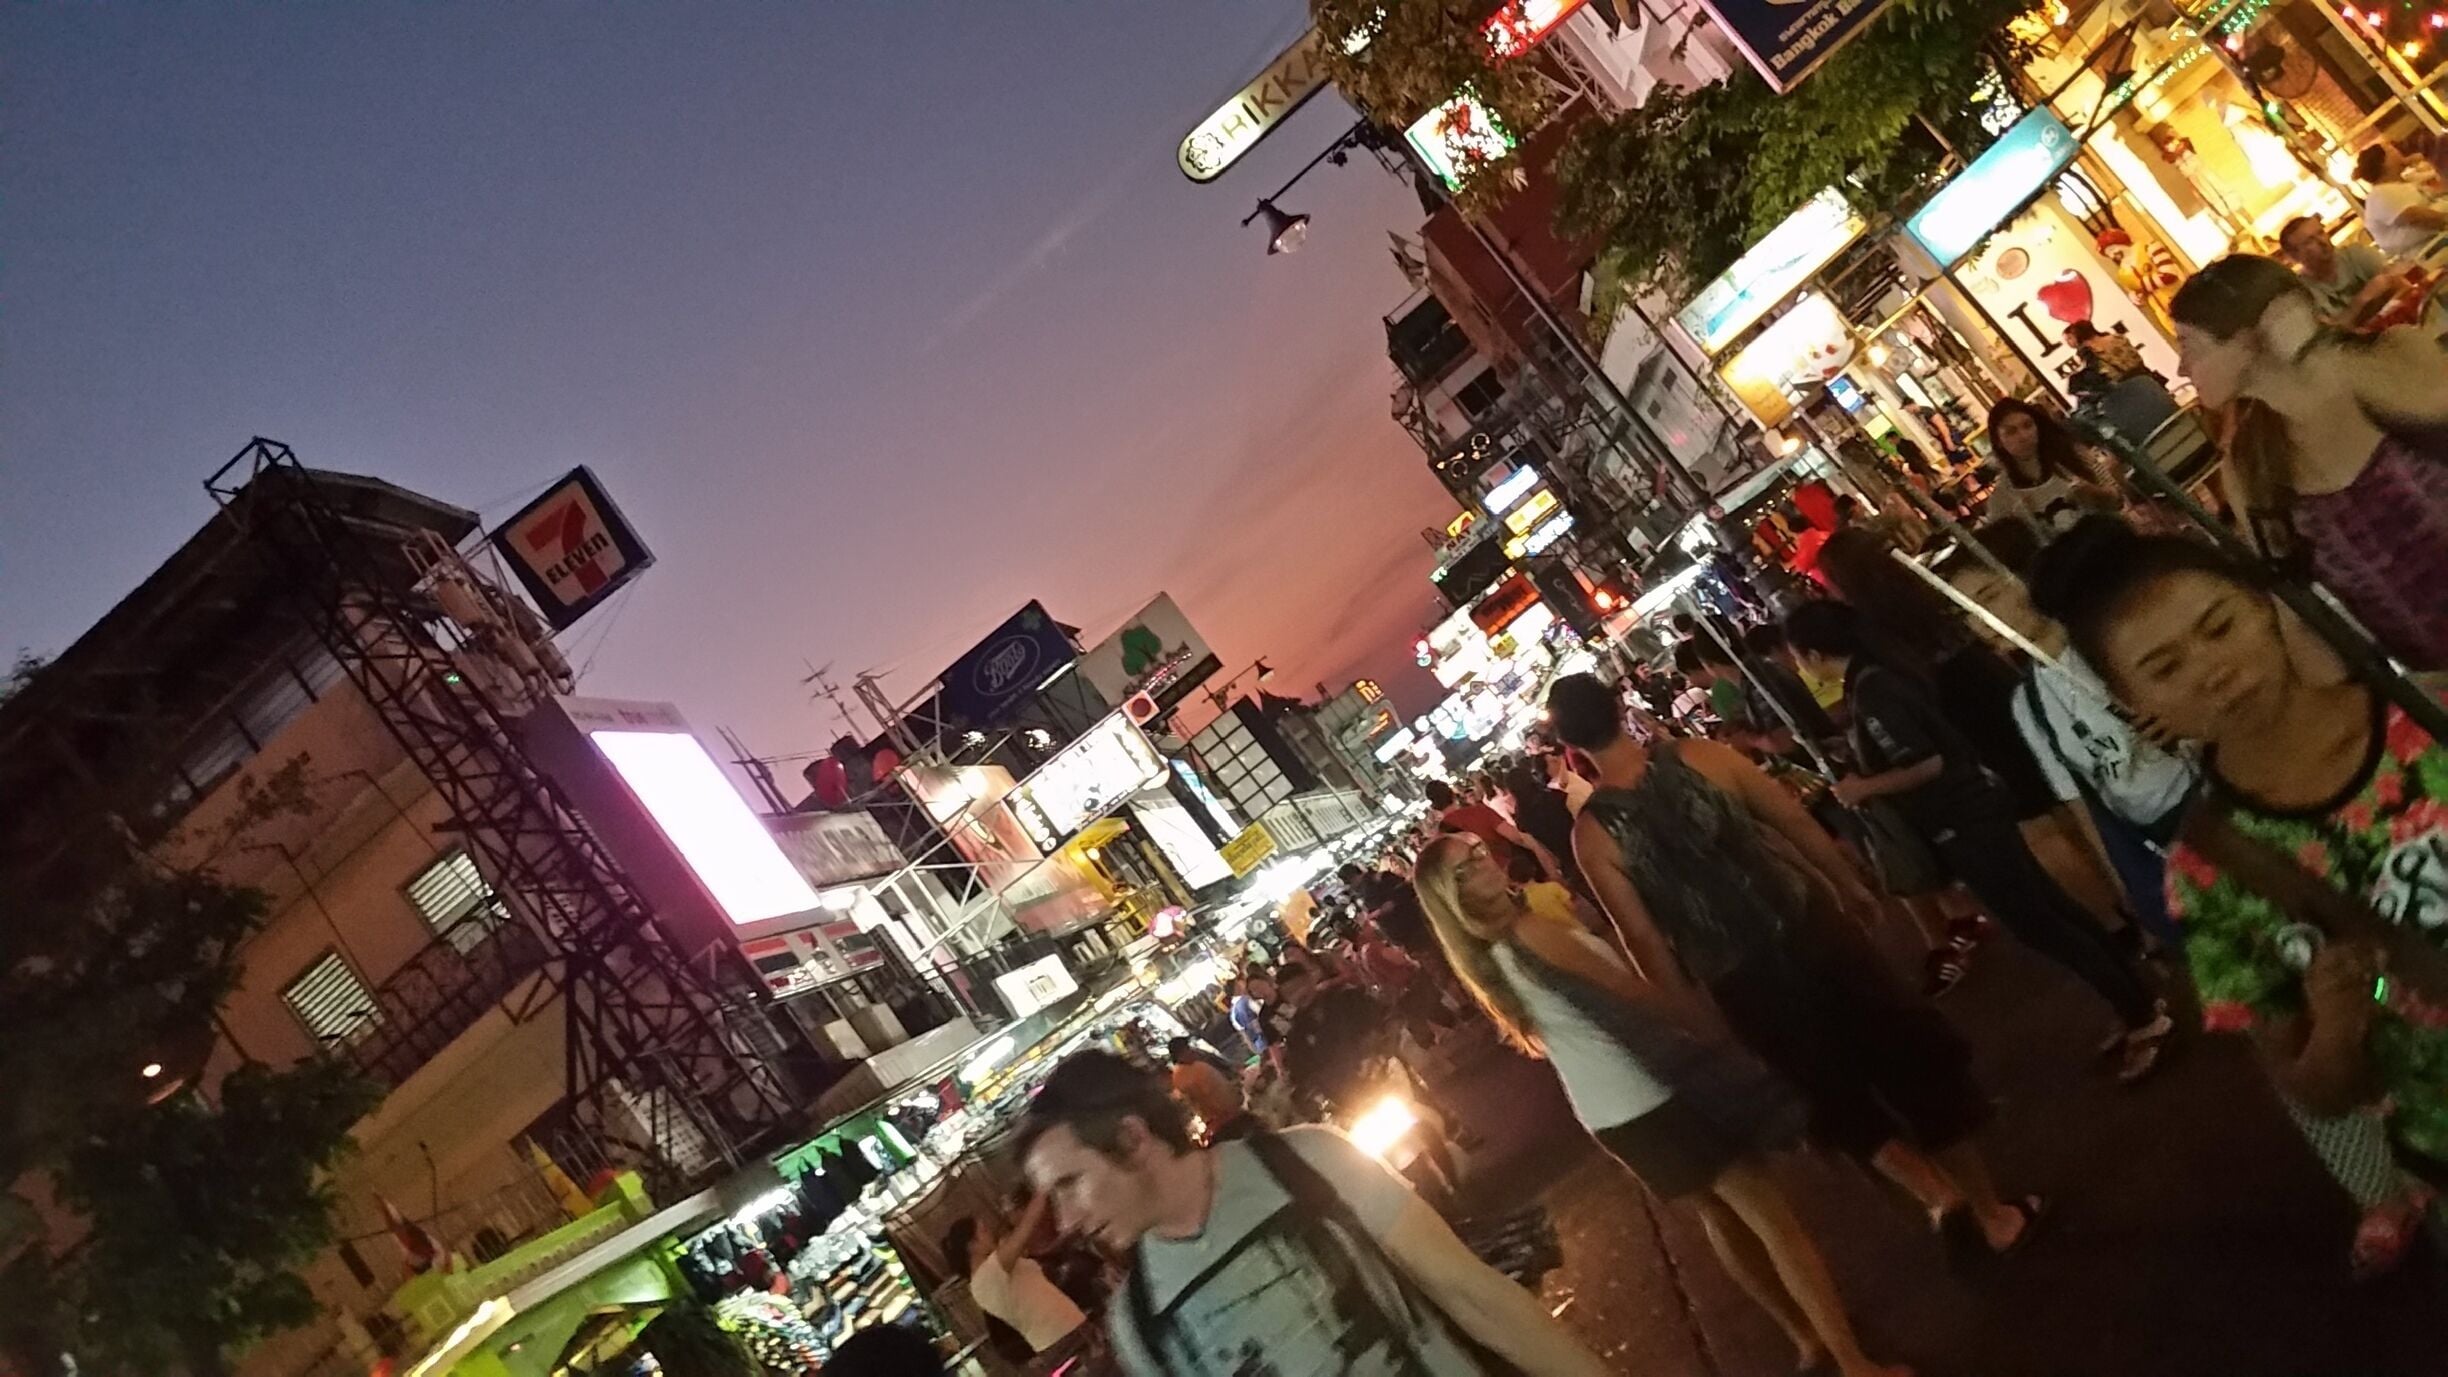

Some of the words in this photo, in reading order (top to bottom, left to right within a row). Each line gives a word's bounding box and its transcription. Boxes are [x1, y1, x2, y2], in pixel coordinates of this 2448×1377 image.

[1770, 13, 1840, 70] Bangkok
[2007, 301, 2063, 357] I
[984, 641, 1026, 692] Boots
